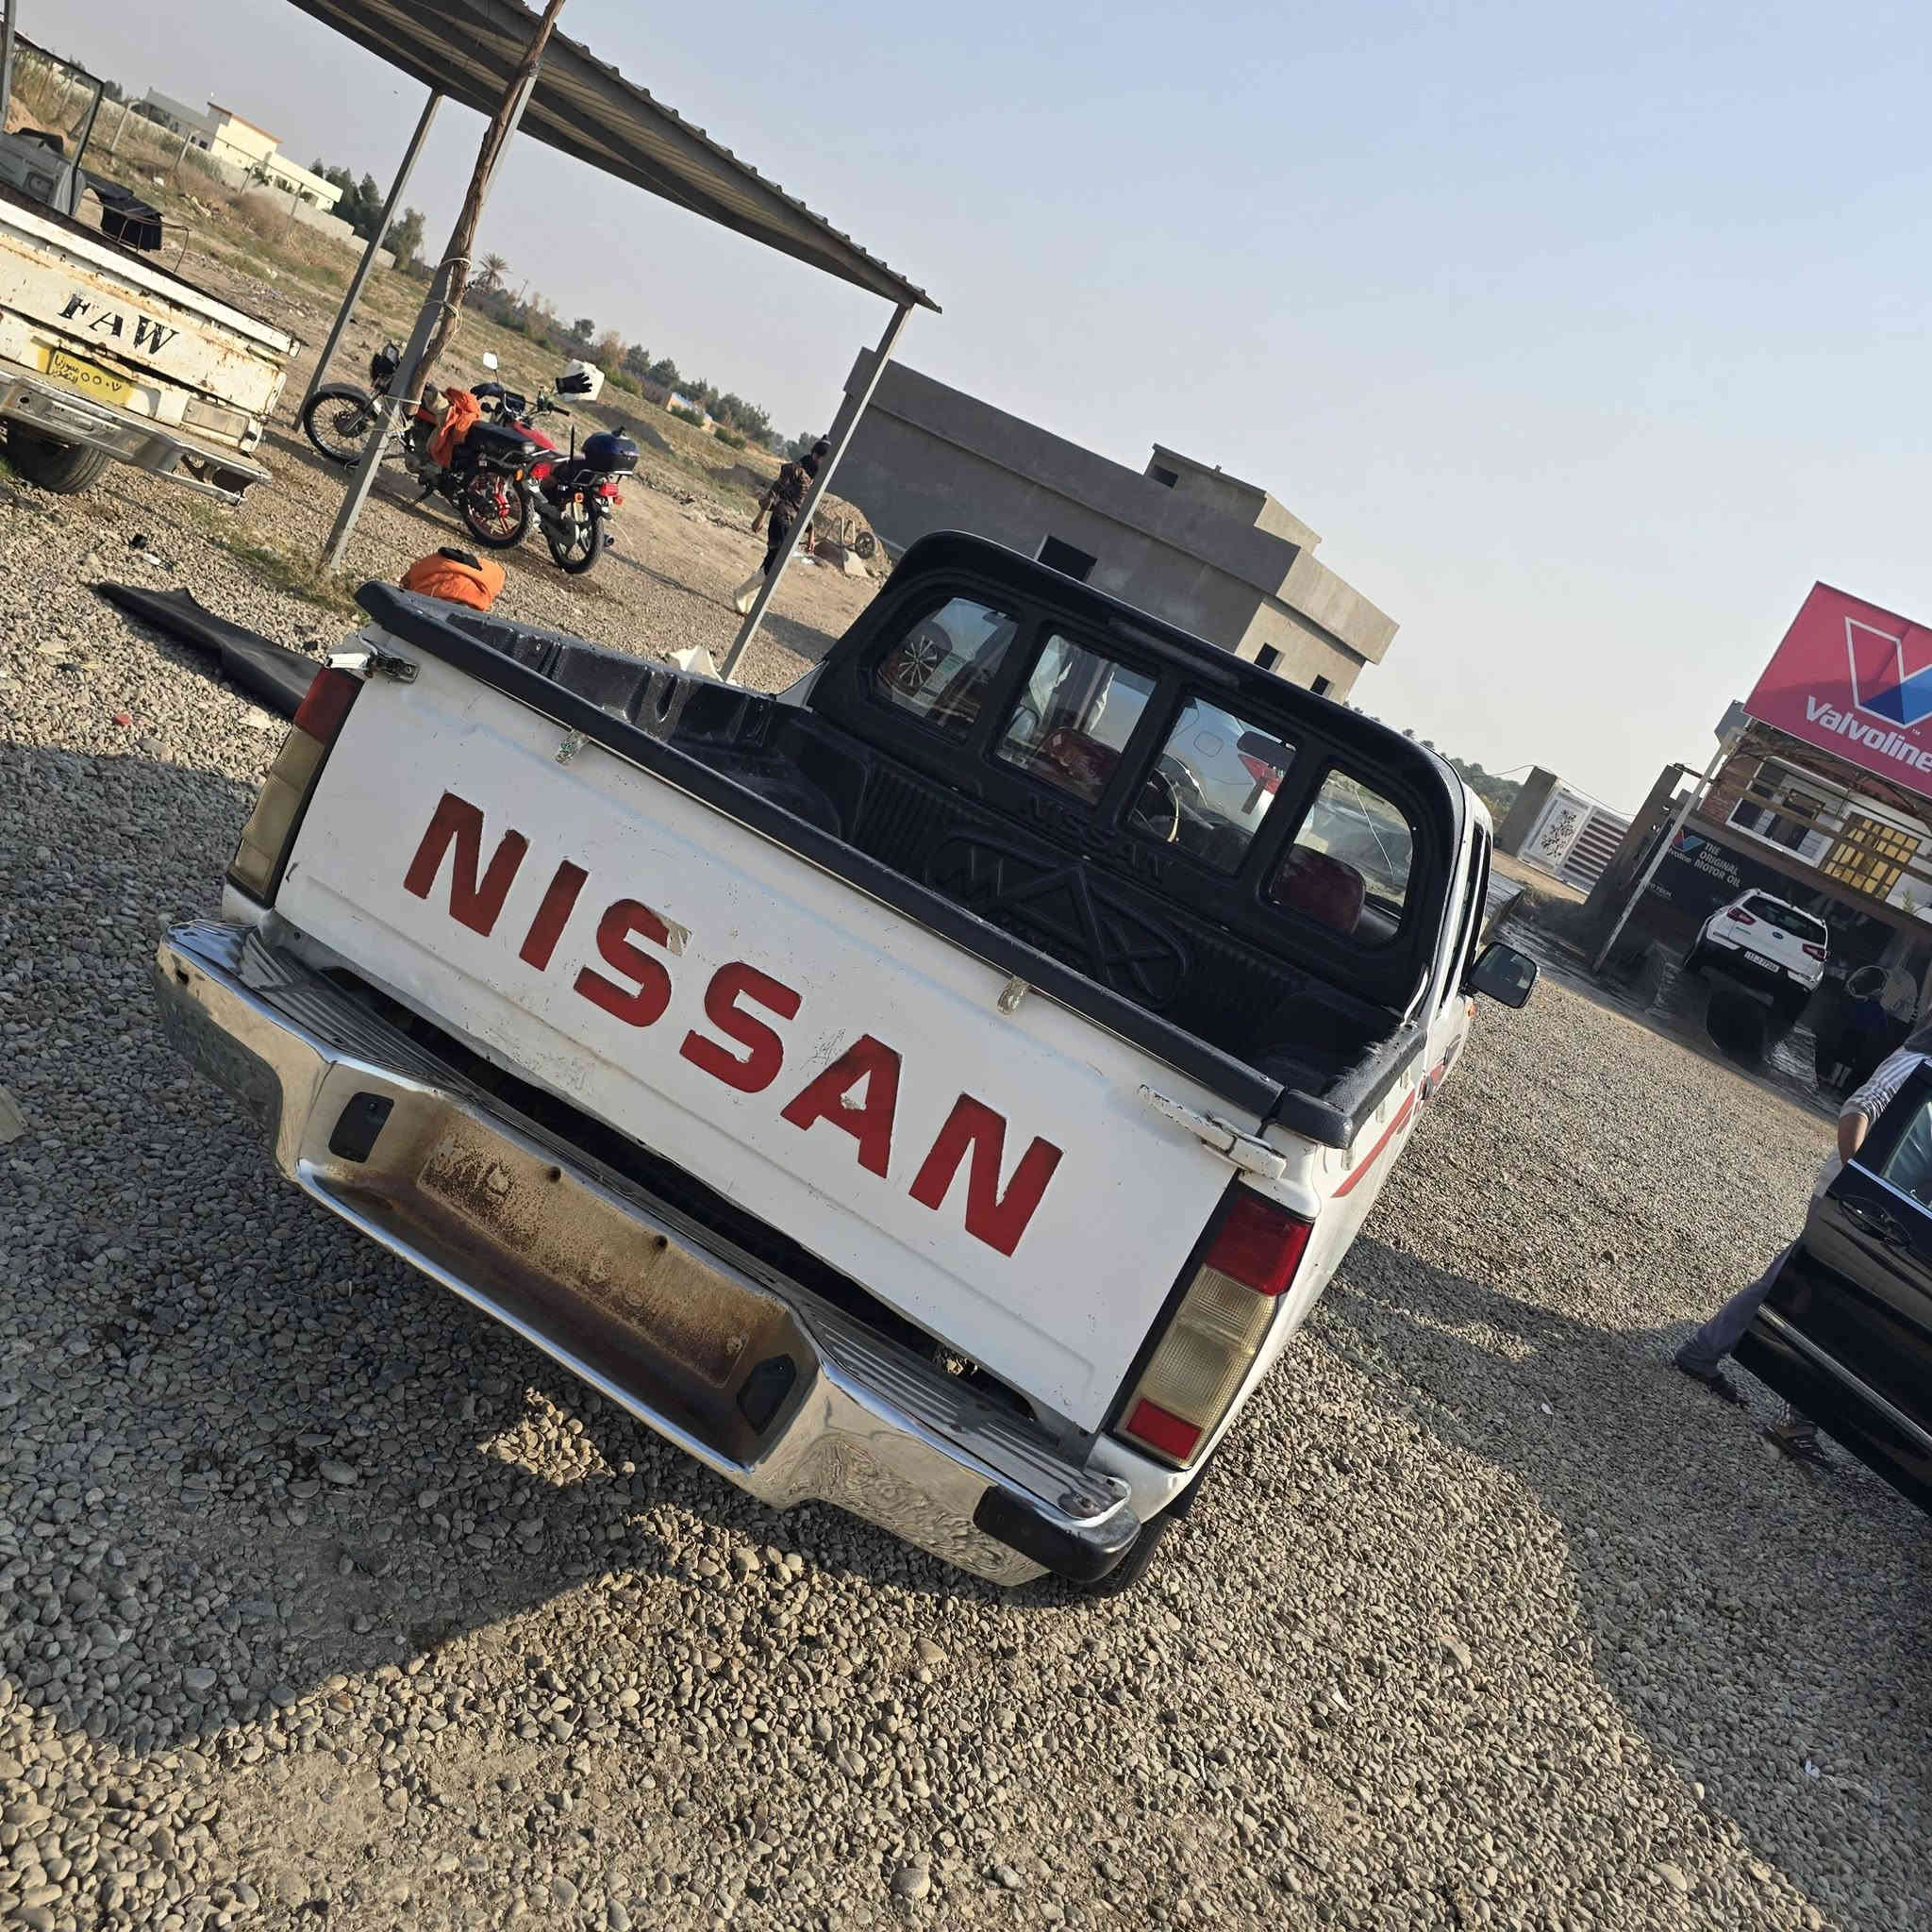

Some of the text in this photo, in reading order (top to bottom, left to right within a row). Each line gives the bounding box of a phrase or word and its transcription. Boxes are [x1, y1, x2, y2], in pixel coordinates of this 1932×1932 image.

[58, 293, 180, 355] FAW
[1806, 694, 1932, 774] Valvoline
[1699, 851, 1740, 876] ORIGINAL
[1705, 841, 1722, 856] THE
[1694, 858, 1741, 888] MOTOR OIL
[404, 790, 1064, 1257] NISSAN
